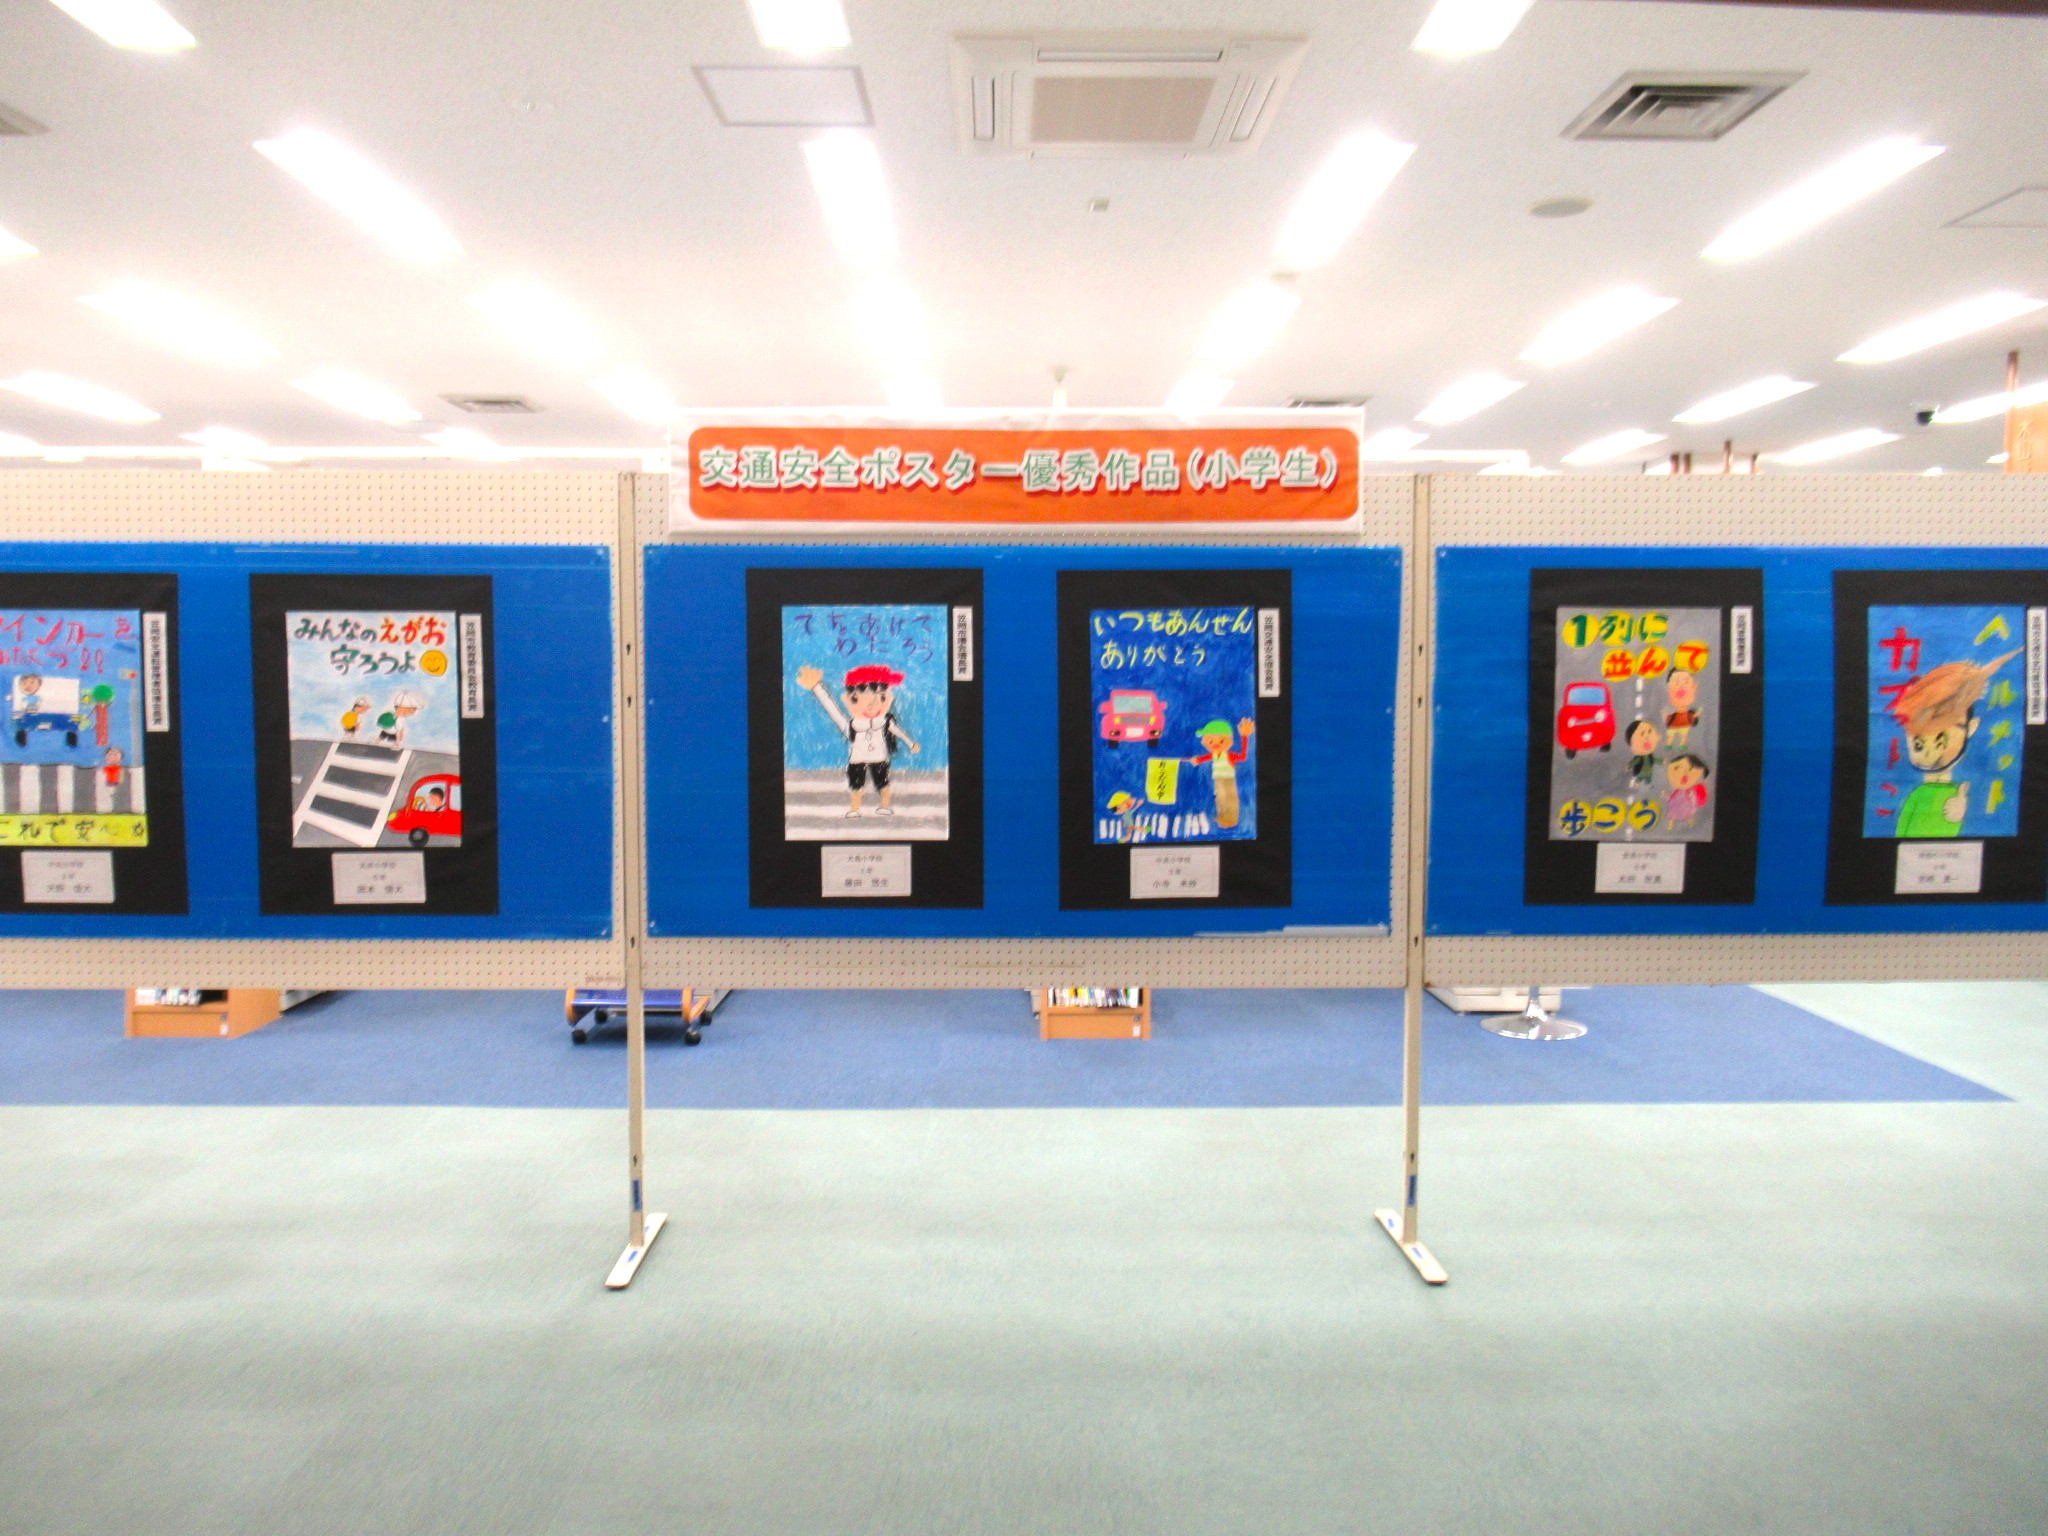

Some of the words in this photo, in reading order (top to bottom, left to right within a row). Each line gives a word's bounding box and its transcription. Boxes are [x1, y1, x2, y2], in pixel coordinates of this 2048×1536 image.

[0, 614, 138, 646] インカーを
[294, 615, 447, 646] みんなのえがお
[330, 643, 415, 675] 守ろうよ
[1101, 639, 1206, 670] ありがとう
[1561, 799, 1657, 838] 歩こう
